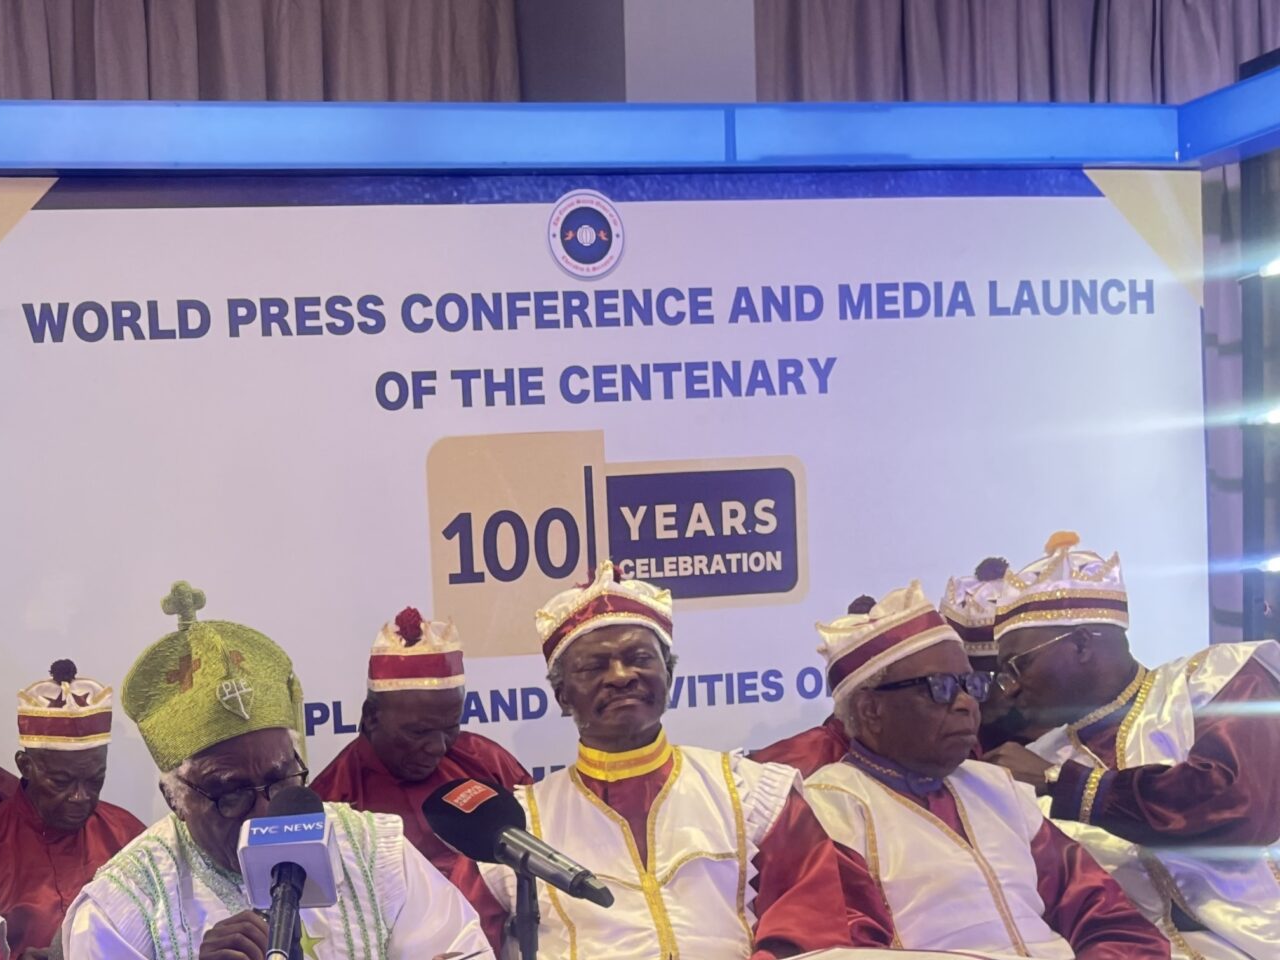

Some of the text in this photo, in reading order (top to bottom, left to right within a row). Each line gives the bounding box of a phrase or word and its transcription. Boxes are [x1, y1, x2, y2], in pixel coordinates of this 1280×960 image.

[22, 278, 1155, 343] WORLD PRESS CONFERENCE AND MEDIA LAUNCH
[375, 357, 837, 411] OF THE CENTENARY
[442, 507, 581, 584] 100
[620, 499, 777, 541] YEARS
[619, 551, 782, 579] CELEBRATION
[460, 687, 548, 725] AND
[796, 667, 833, 700] O
[250, 822, 323, 835] TVC NEWS
